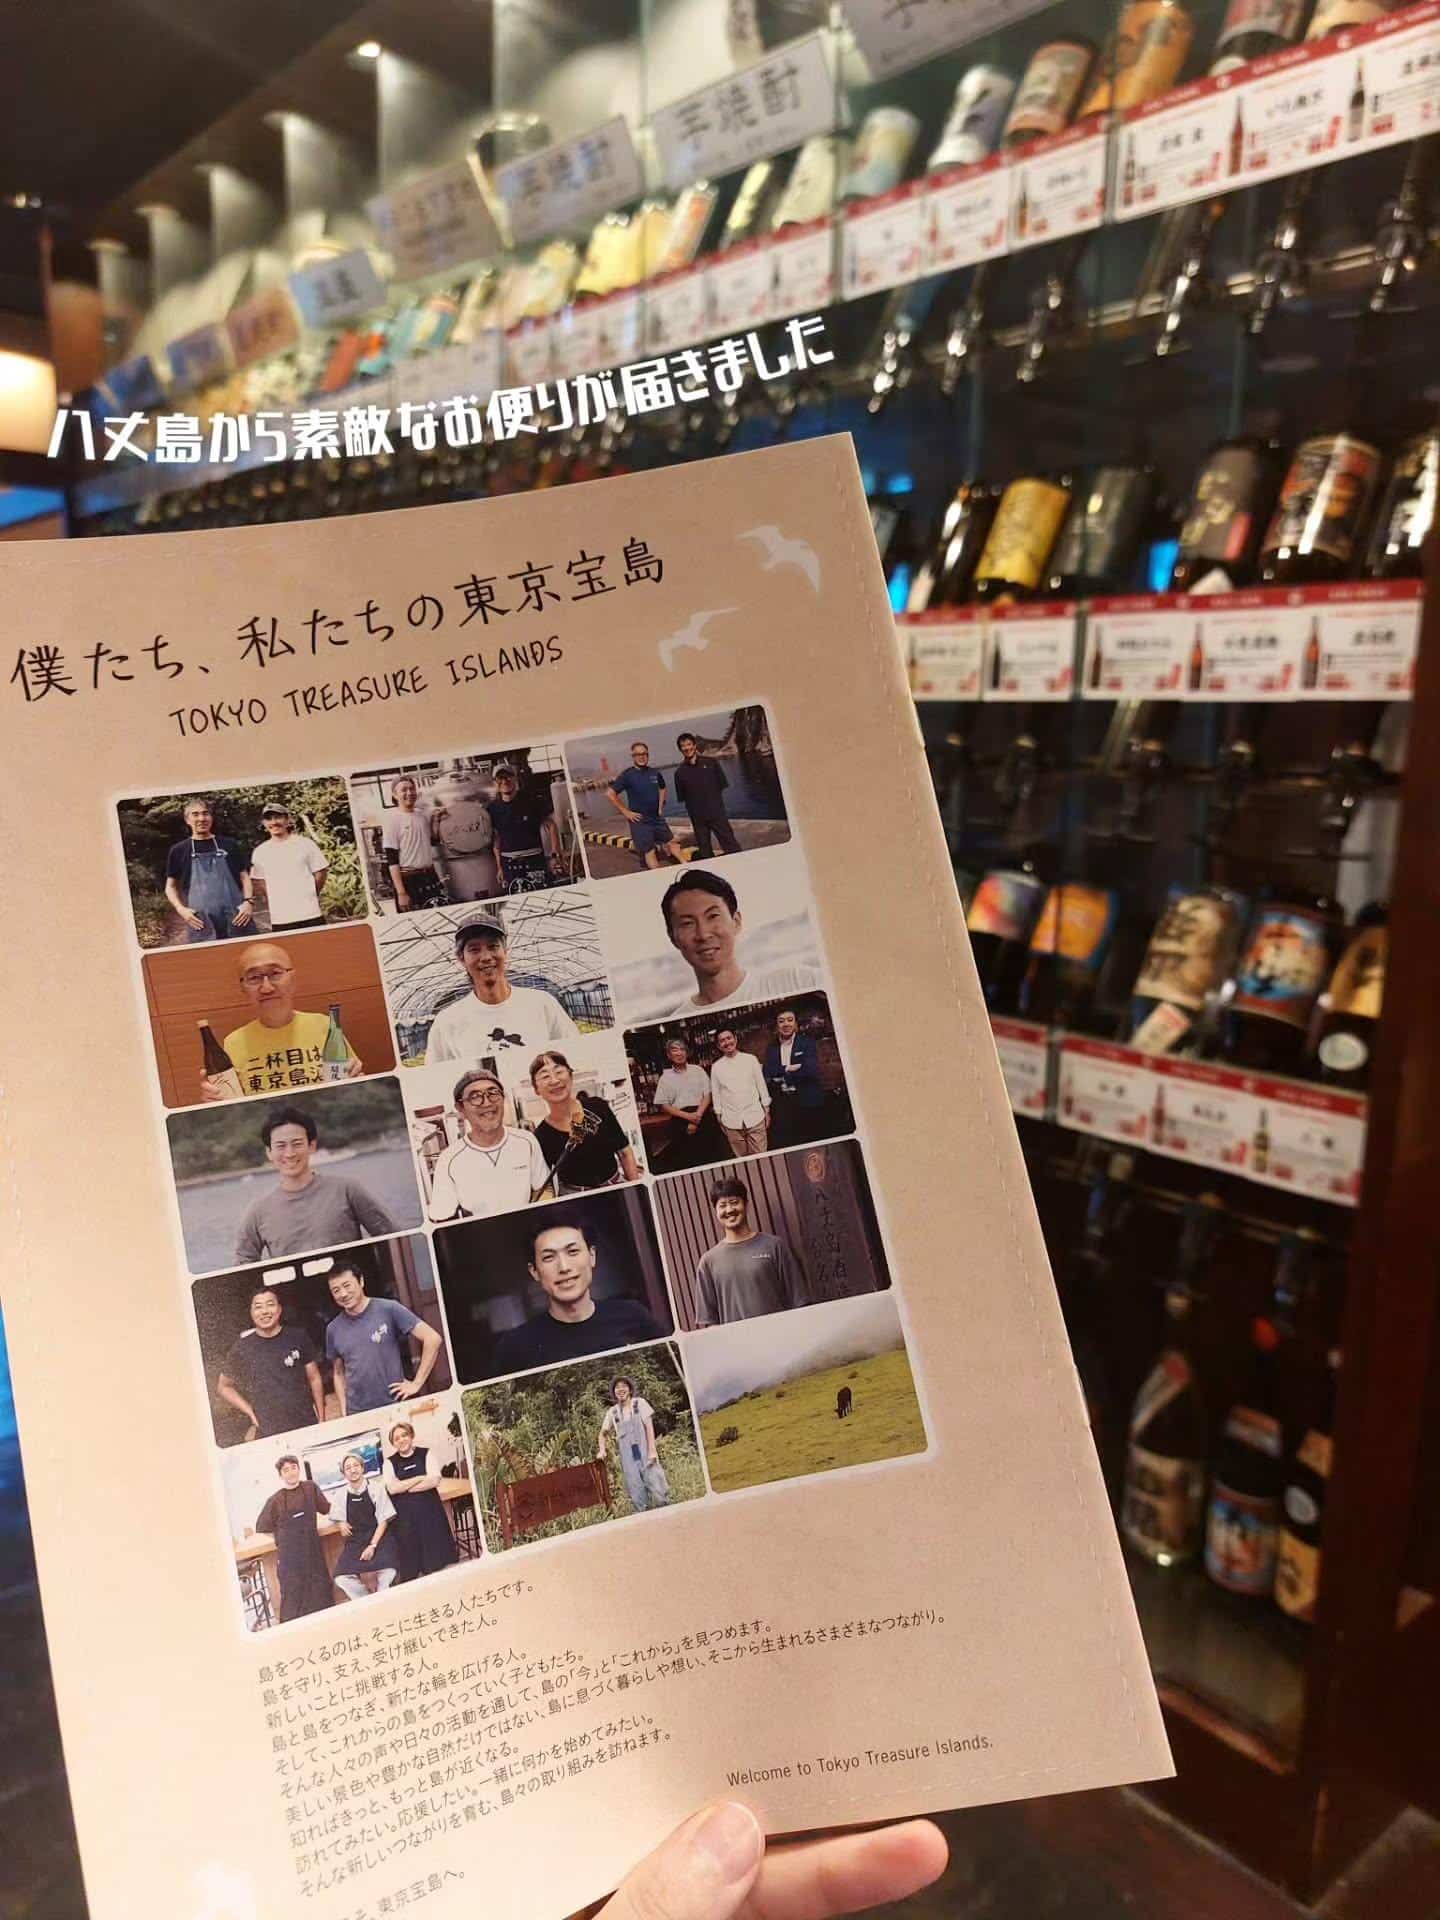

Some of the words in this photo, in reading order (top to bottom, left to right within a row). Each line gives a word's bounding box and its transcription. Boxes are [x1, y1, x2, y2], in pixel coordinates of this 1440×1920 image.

[9, 535, 665, 704] 僕たち、私たちの東京宝島
[168, 698, 268, 738] TOKYO
[282, 664, 428, 721] TREASURE
[447, 634, 564, 686] ISLANDS
[247, 1046, 323, 1072] 二杯目は
[258, 1579, 534, 1684] 島をつくるのは、そこに生きる人たちです。
[262, 1615, 499, 1708] 島を守り、支え、受け継いできた人。
[266, 1660, 440, 1731] 新しいことに挑戦する人。
[271, 1648, 528, 1753] 島と島をつなぎ、新たな輪を広げる人。
[275, 1648, 585, 1776] そして、これからの島をつくっていく子どもたち。
[290, 1743, 520, 1848] 知ればきっと、もっと島が近くなる。
[727, 1759, 791, 1787] Welcome
[797, 1757, 812, 1777] to
[817, 1751, 860, 1774] Tokyo
[866, 1744, 930, 1767] Treasure
[936, 1732, 993, 1756] Islands.
